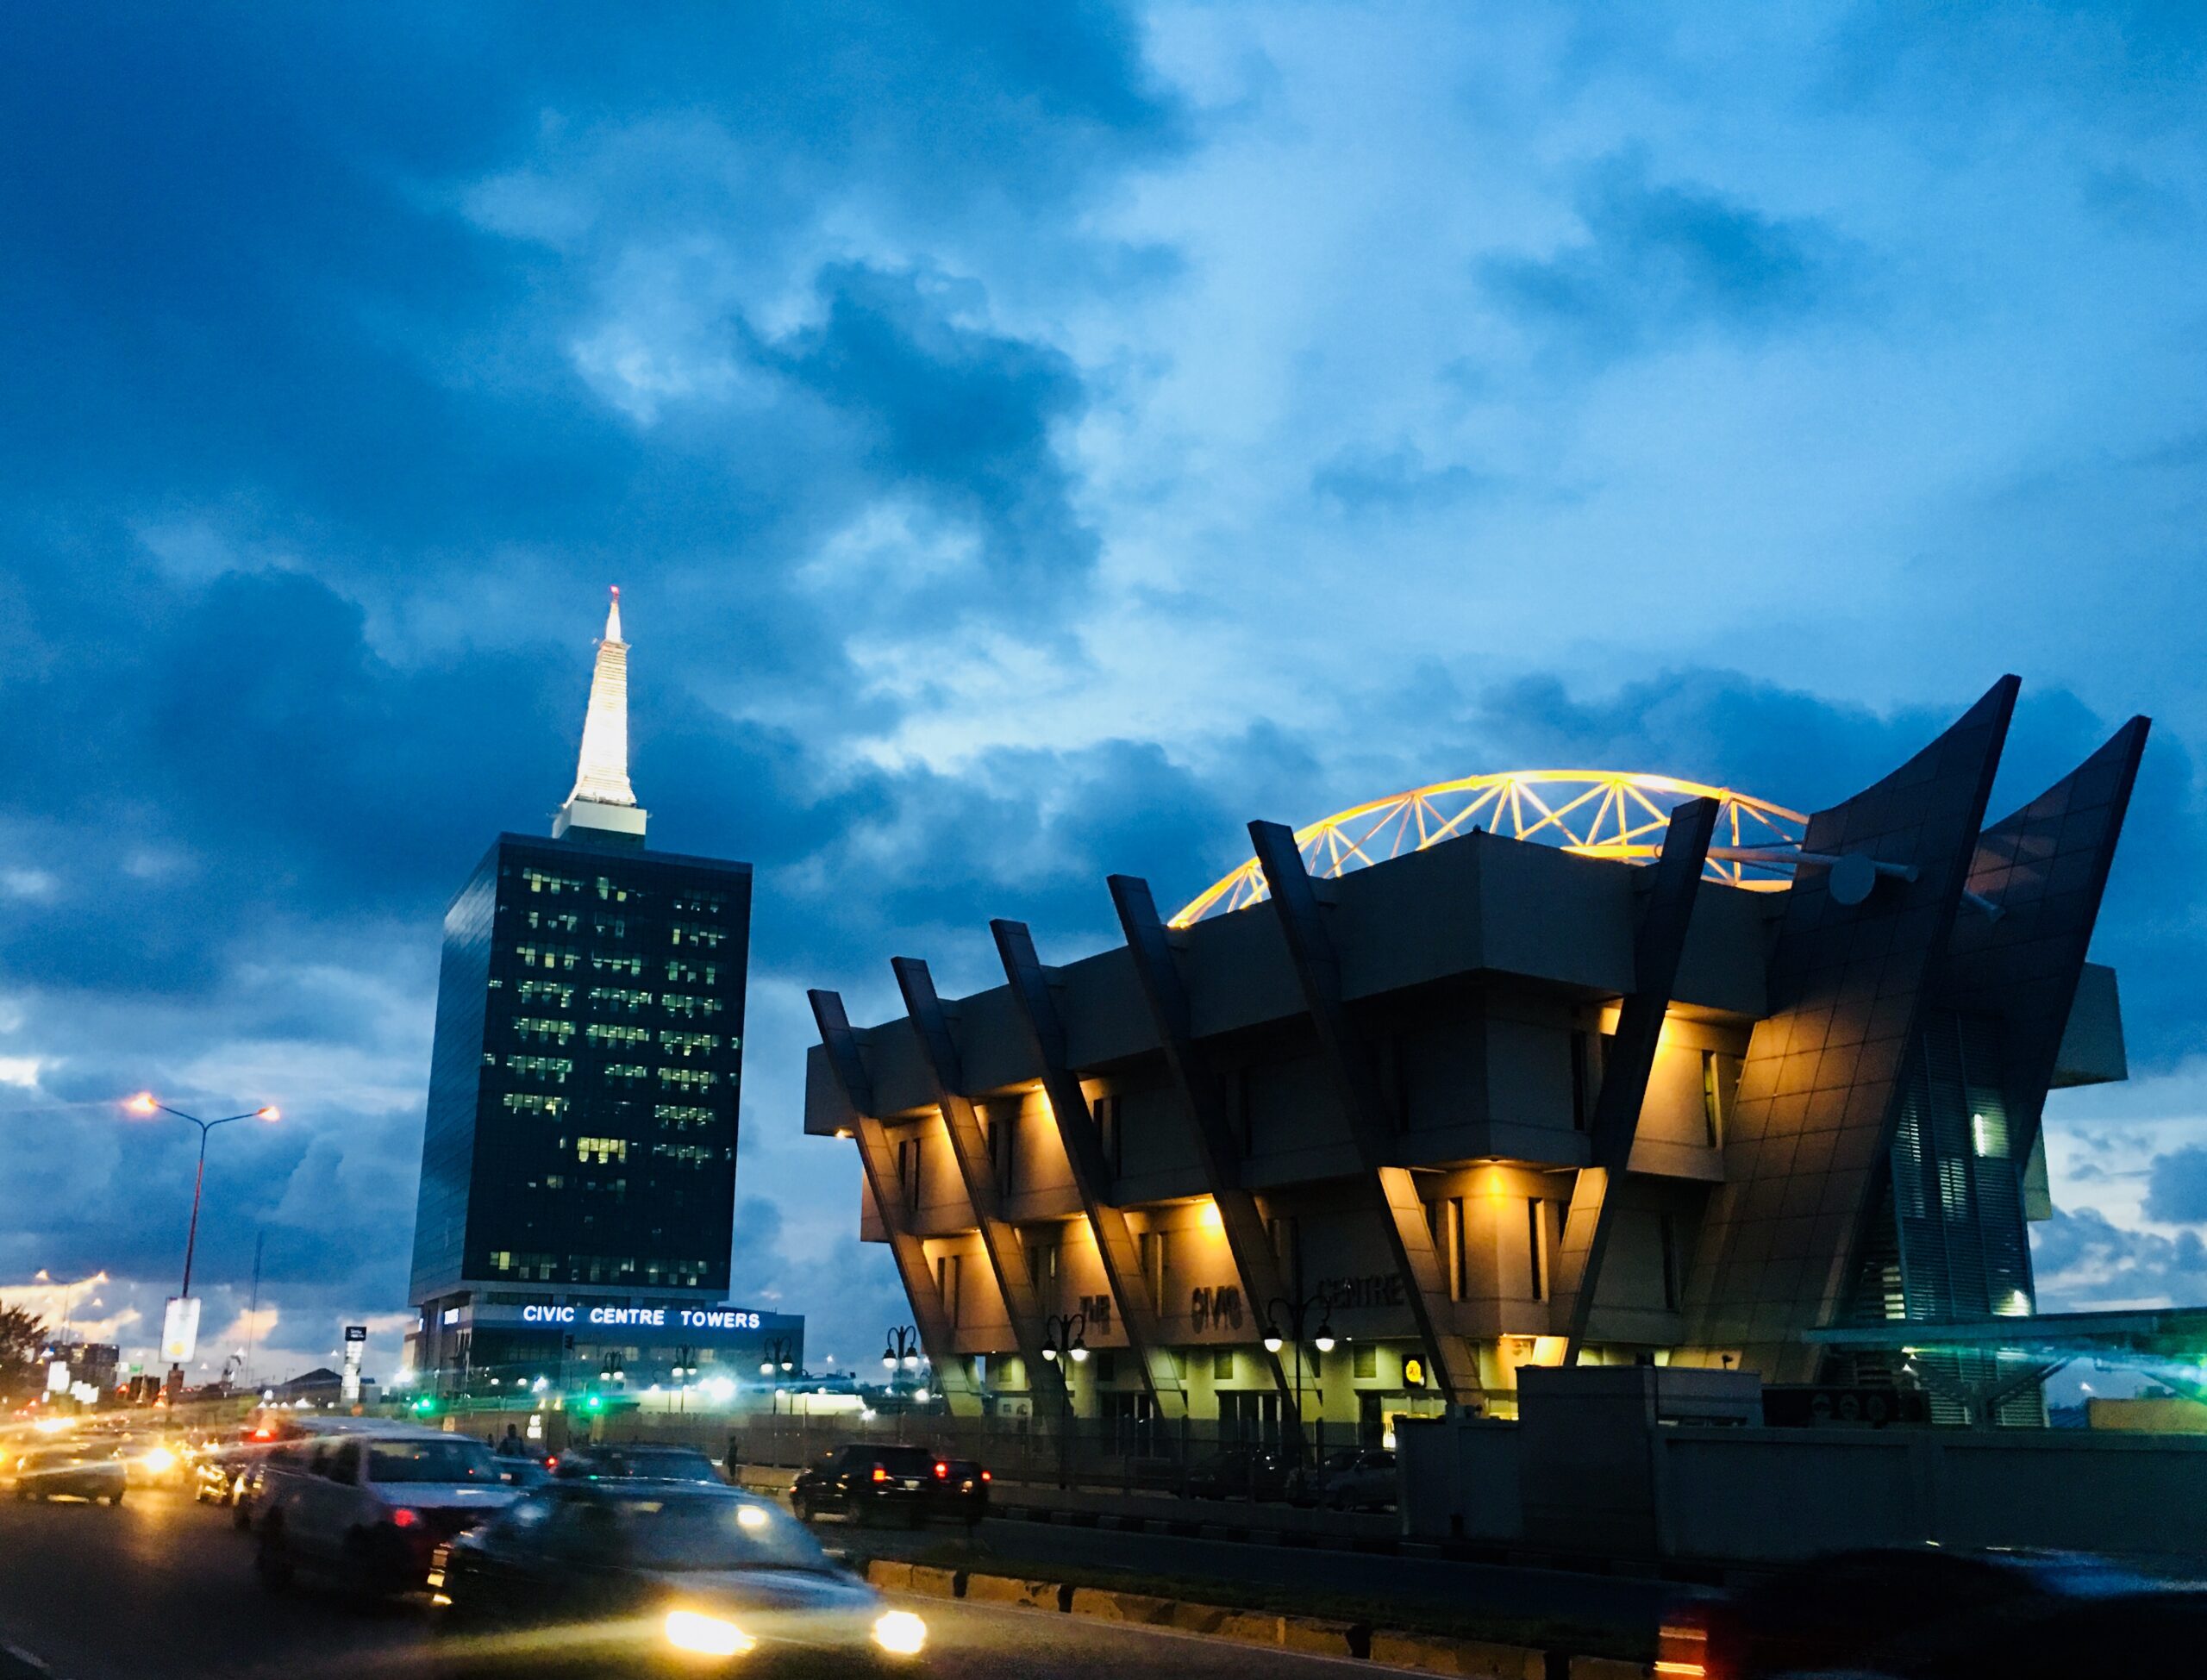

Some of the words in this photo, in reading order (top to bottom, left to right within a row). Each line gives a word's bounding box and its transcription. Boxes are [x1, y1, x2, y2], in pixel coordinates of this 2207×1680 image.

[522, 1305, 575, 1322] CIVIC
[590, 1308, 665, 1326] CENTRE
[680, 1310, 760, 1329] TOWERS
